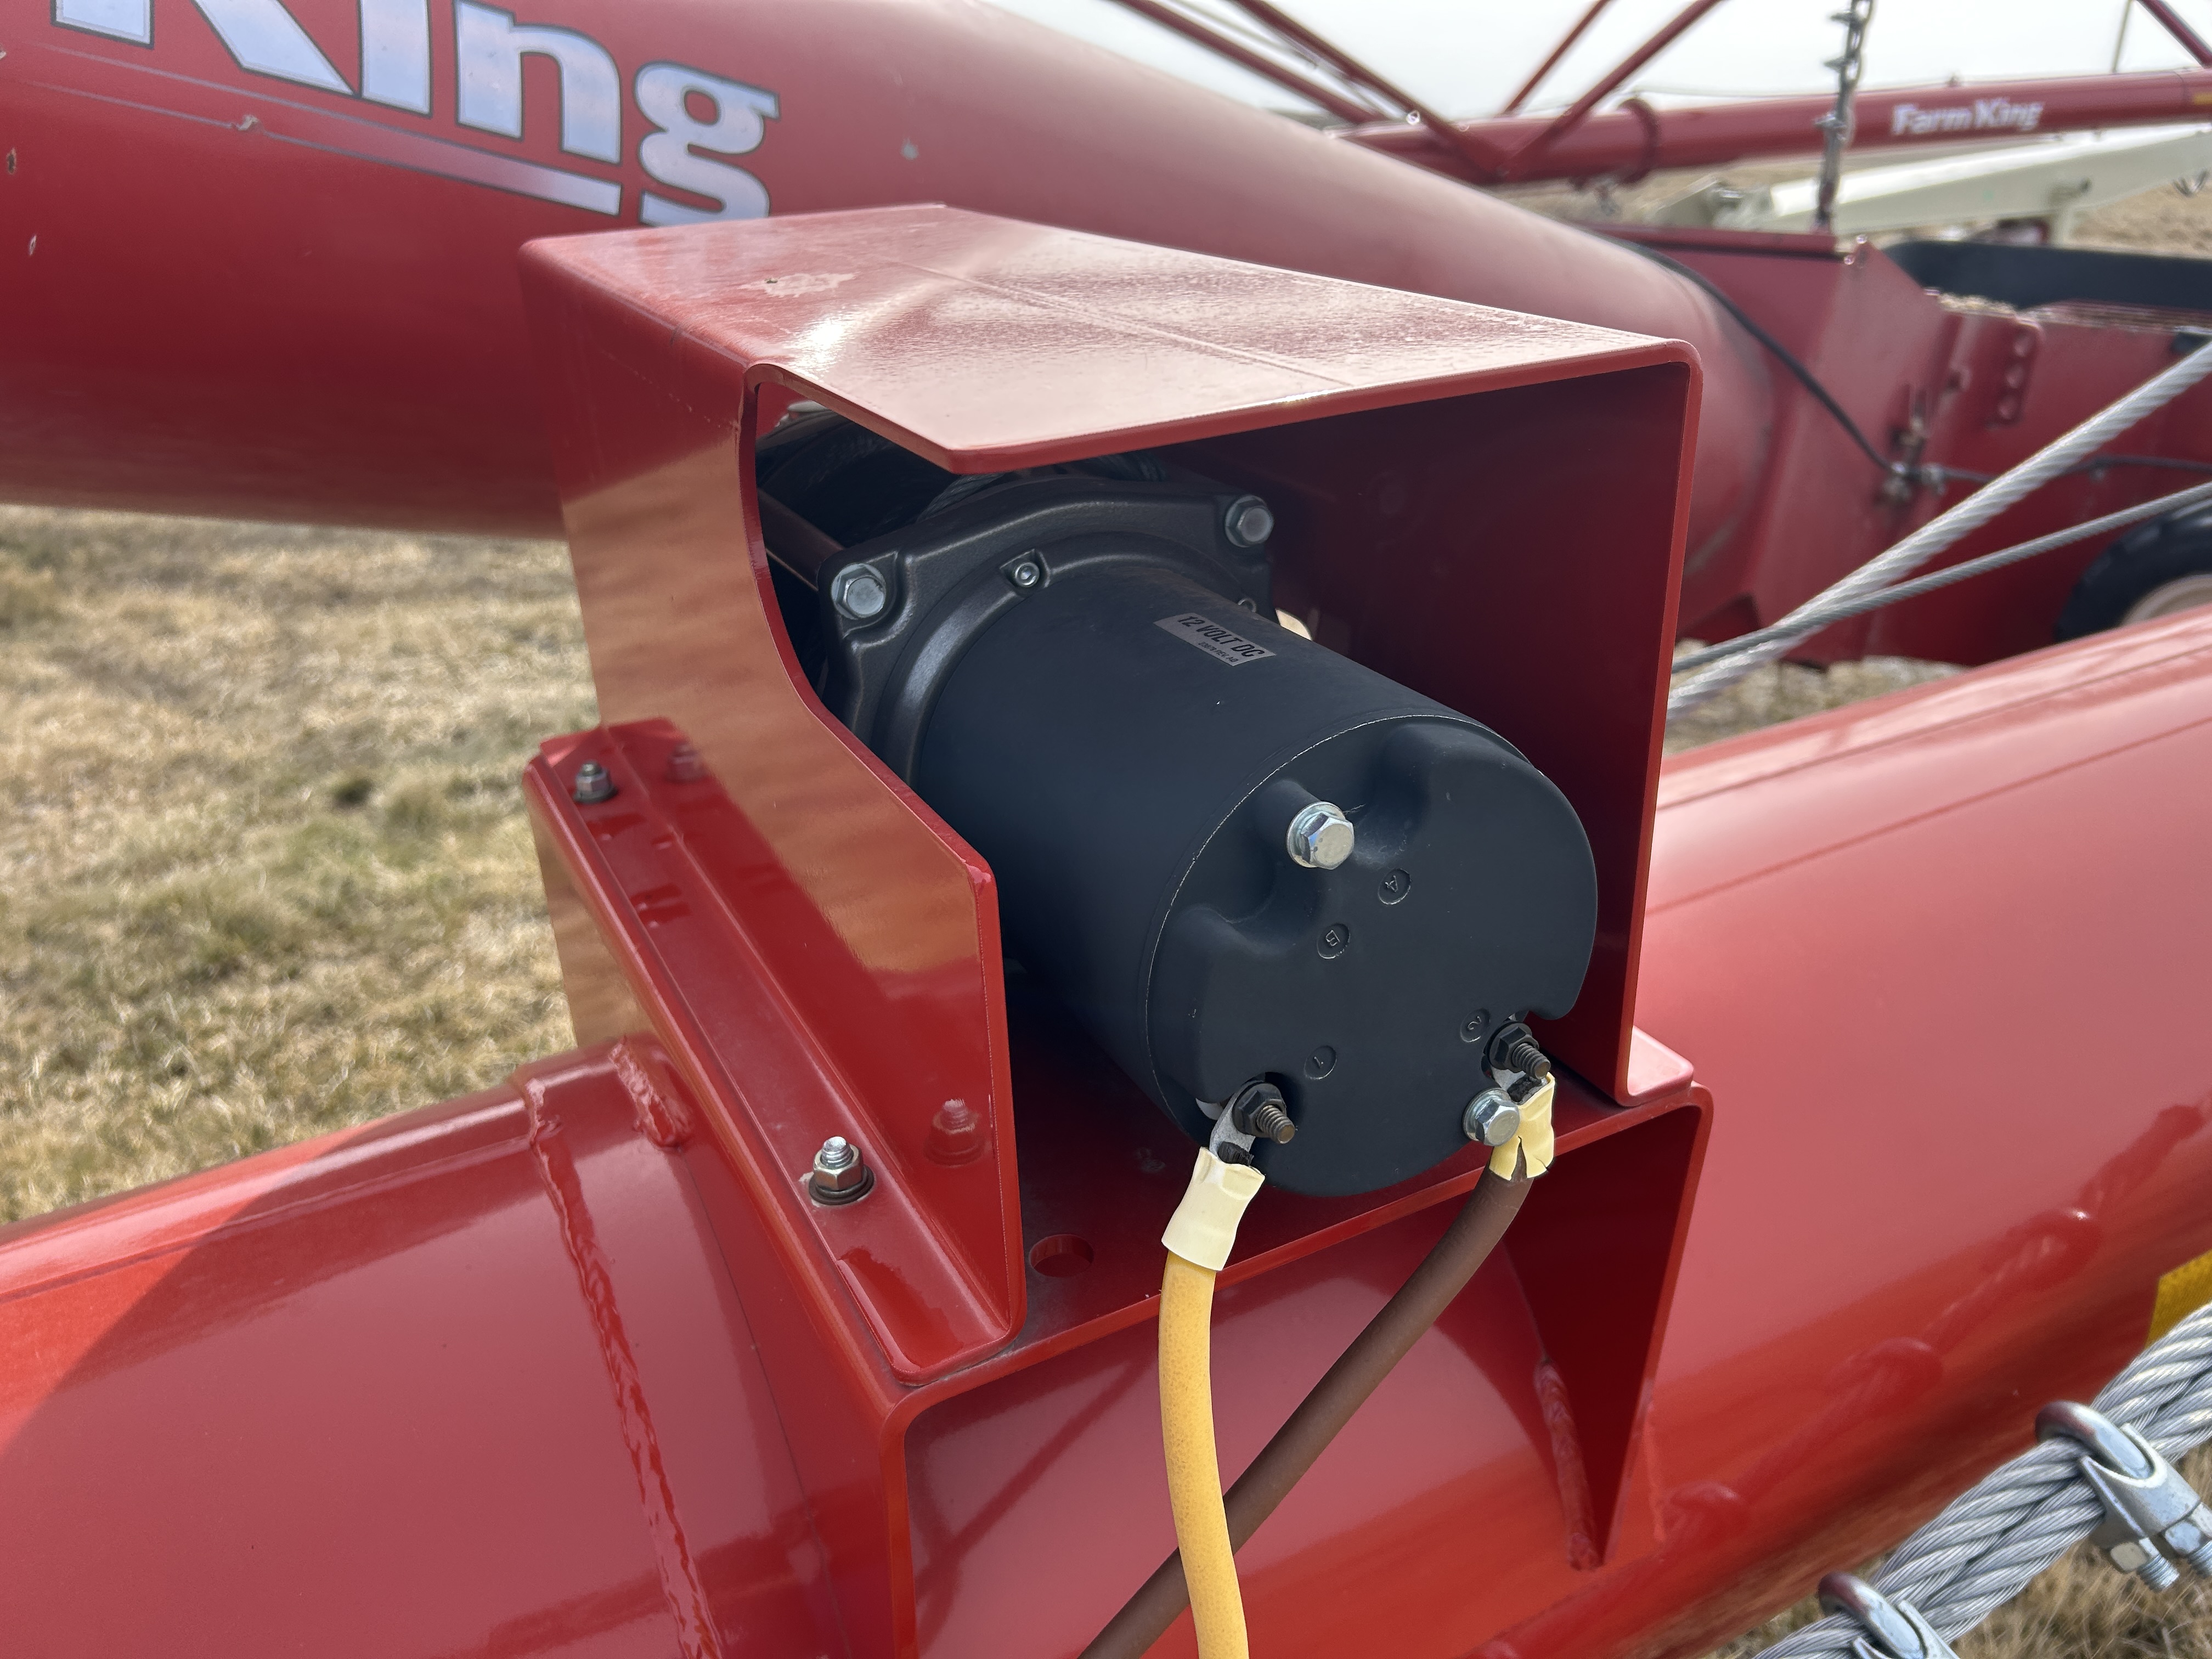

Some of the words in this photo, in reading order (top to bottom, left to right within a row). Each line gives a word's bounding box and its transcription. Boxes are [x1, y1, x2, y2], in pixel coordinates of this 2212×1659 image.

[50, 0, 780, 227] ing
[1891, 103, 1973, 136] Farm
[1974, 97, 2045, 132] King
[1177, 616, 1205, 627] 12
[1195, 625, 1243, 645] VOLT
[1231, 644, 1265, 657] DC
[1325, 929, 1340, 946] B
